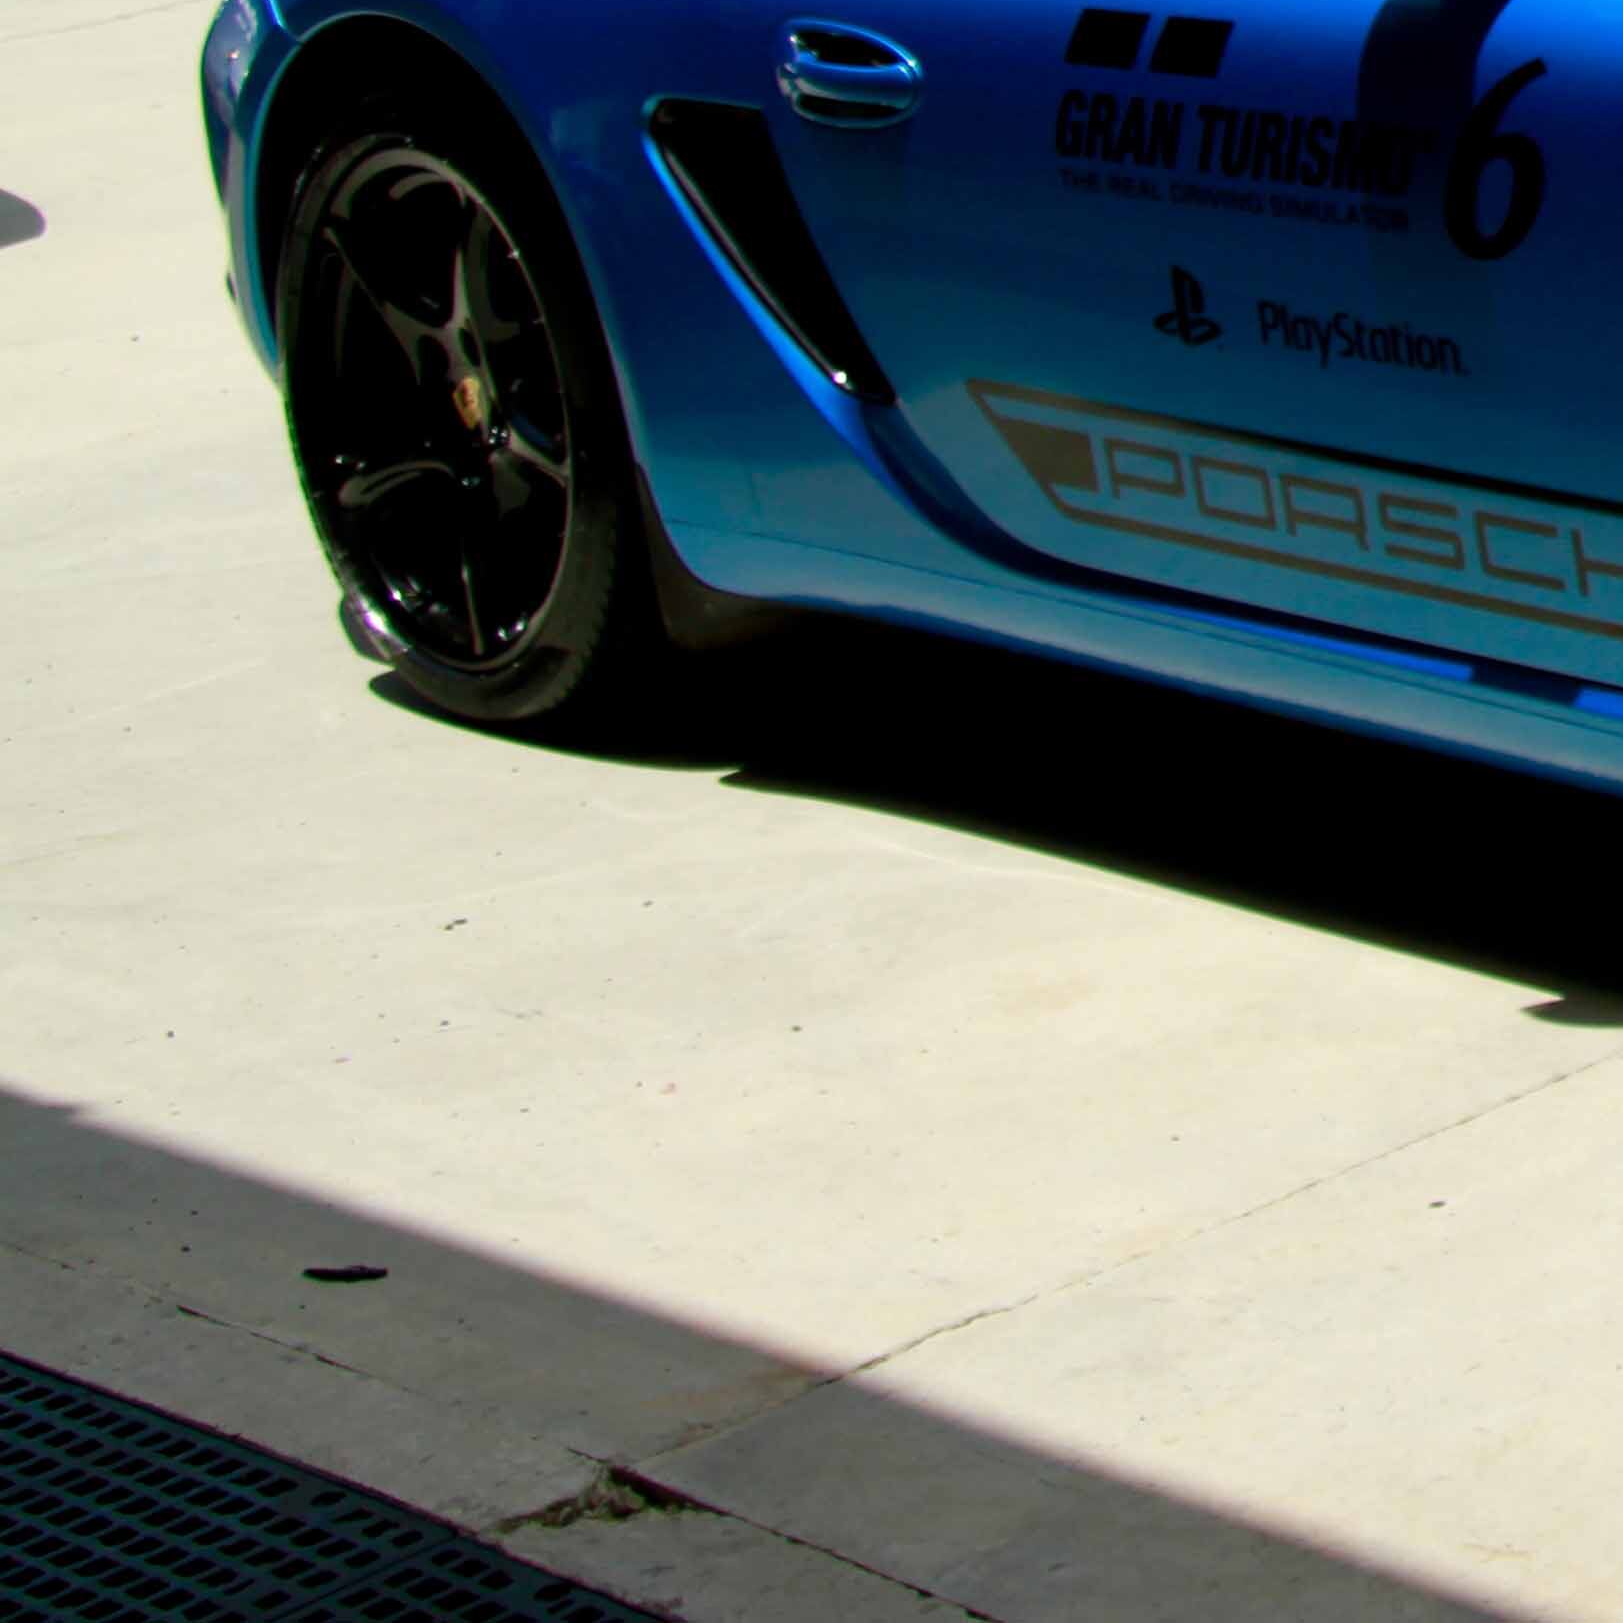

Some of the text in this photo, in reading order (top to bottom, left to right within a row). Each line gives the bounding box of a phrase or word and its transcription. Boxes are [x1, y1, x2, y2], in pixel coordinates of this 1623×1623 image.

[1055, 57, 1548, 261] GRAN TURISMO 6
[1257, 299, 1470, 375] PlayStation
